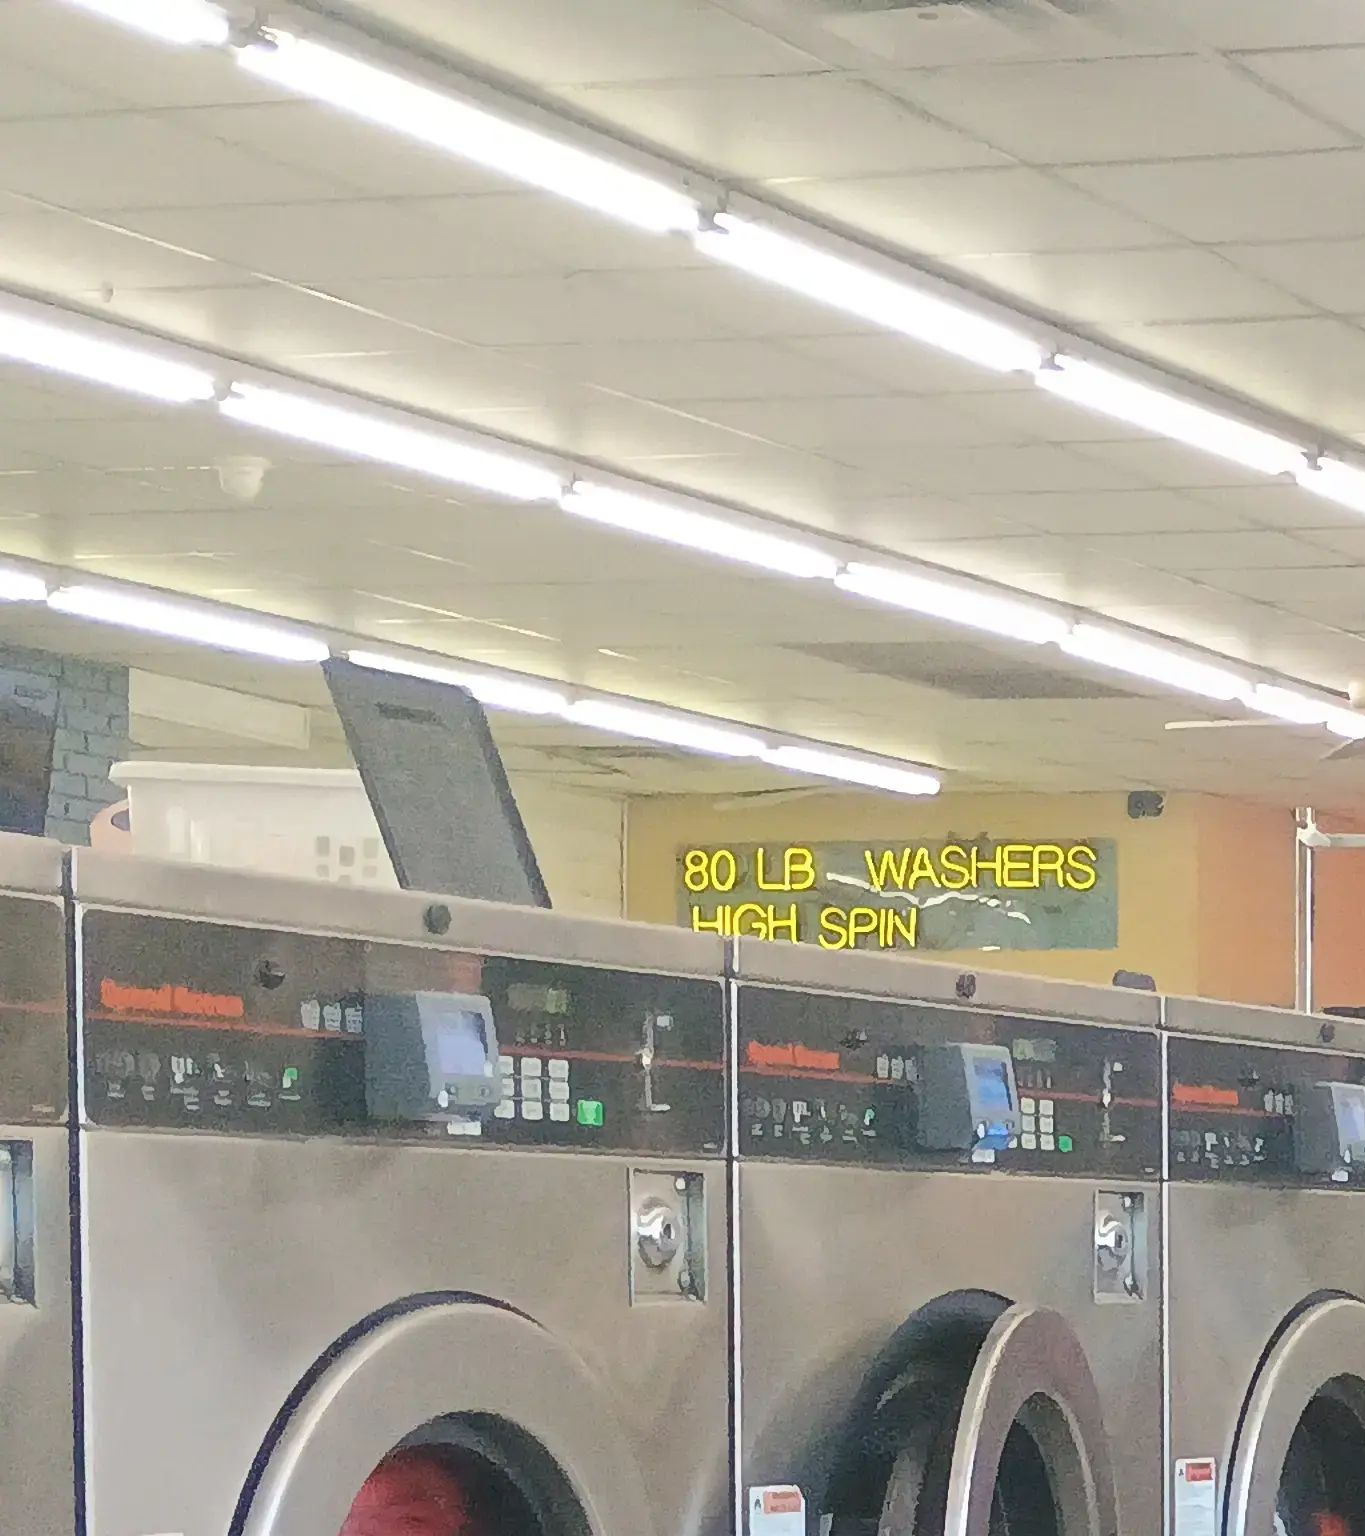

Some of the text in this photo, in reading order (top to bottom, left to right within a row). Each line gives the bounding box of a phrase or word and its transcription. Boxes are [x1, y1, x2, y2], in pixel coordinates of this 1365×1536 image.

[684, 845, 1097, 891] 80 LB WASHERS
[692, 903, 917, 950] HIGH SPIN
